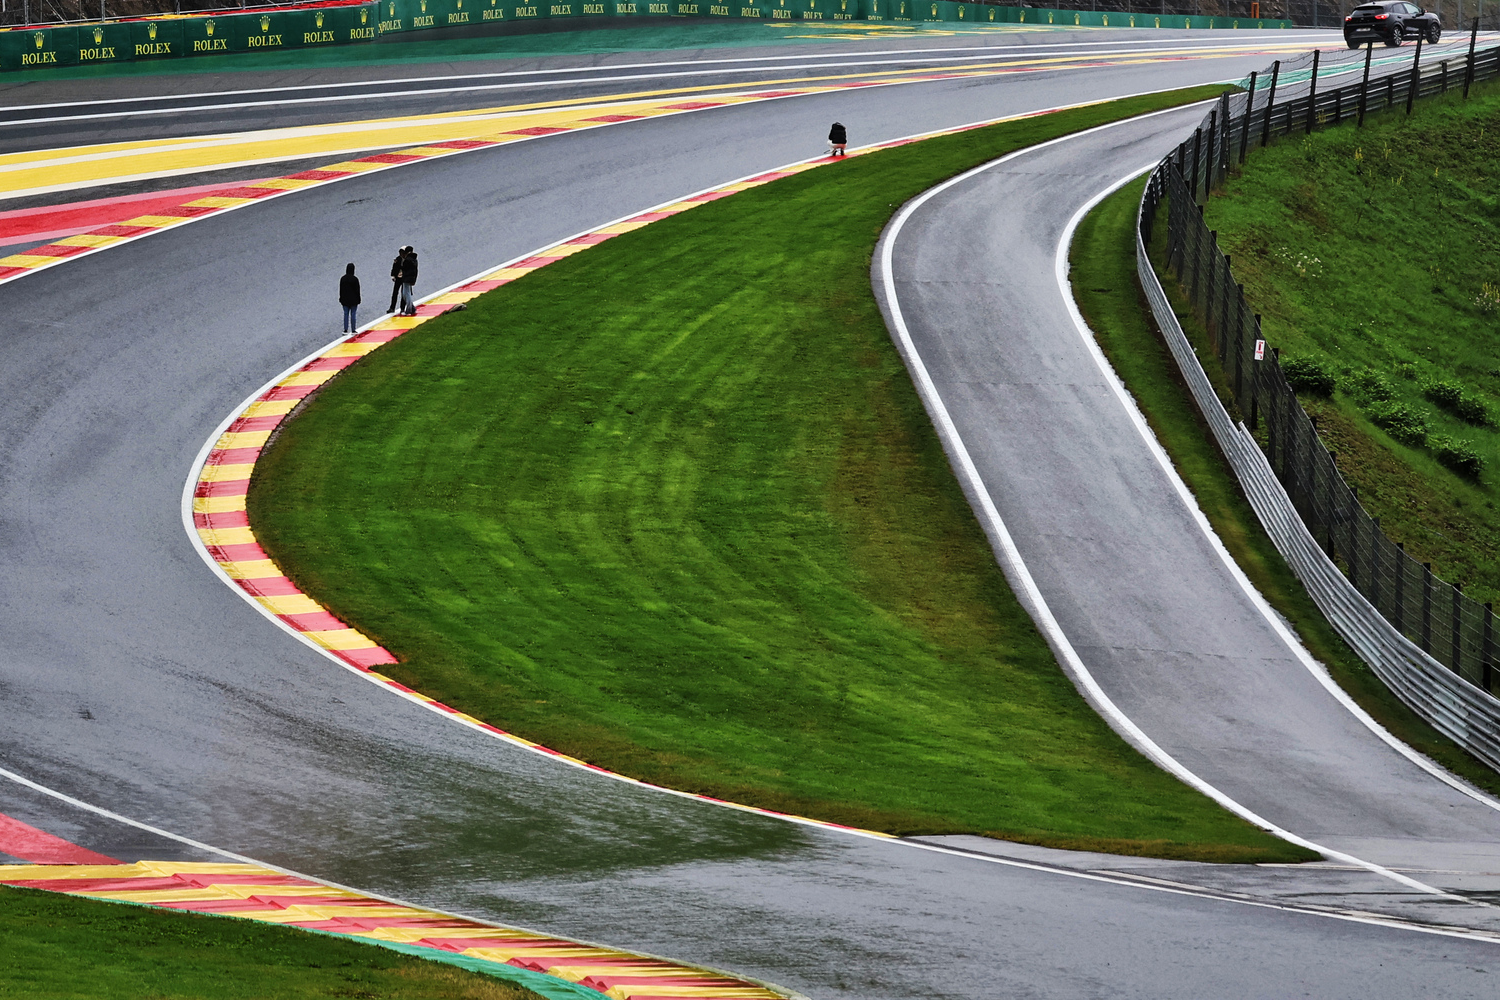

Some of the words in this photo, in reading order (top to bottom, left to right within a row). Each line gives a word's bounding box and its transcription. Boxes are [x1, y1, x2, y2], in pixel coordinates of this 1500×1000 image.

[516, 6, 537, 17] ROLEX
[550, 4, 571, 15] ROLEX
[583, 4, 604, 14] ROLEX
[616, 3, 637, 13] ROLEX
[649, 3, 668, 14] ROLEX
[678, 4, 698, 14] ROLEX
[710, 5, 729, 16] ROLEX
[741, 7, 760, 18] ROLEX
[448, 12, 469, 24] ROLEX
[482, 9, 504, 20] ROLEX
[772, 9, 792, 19] ROLEX
[382, 19, 402, 31] ROLEX
[413, 15, 434, 27] ROLEX
[303, 30, 335, 43] ROLEX
[350, 27, 375, 40] ROLEX
[194, 38, 227, 52] ROLEX
[248, 34, 283, 47] ROLEX
[79, 47, 116, 60] ROLEX
[135, 42, 171, 56] ROLEX
[22, 51, 57, 65] ROLEX
